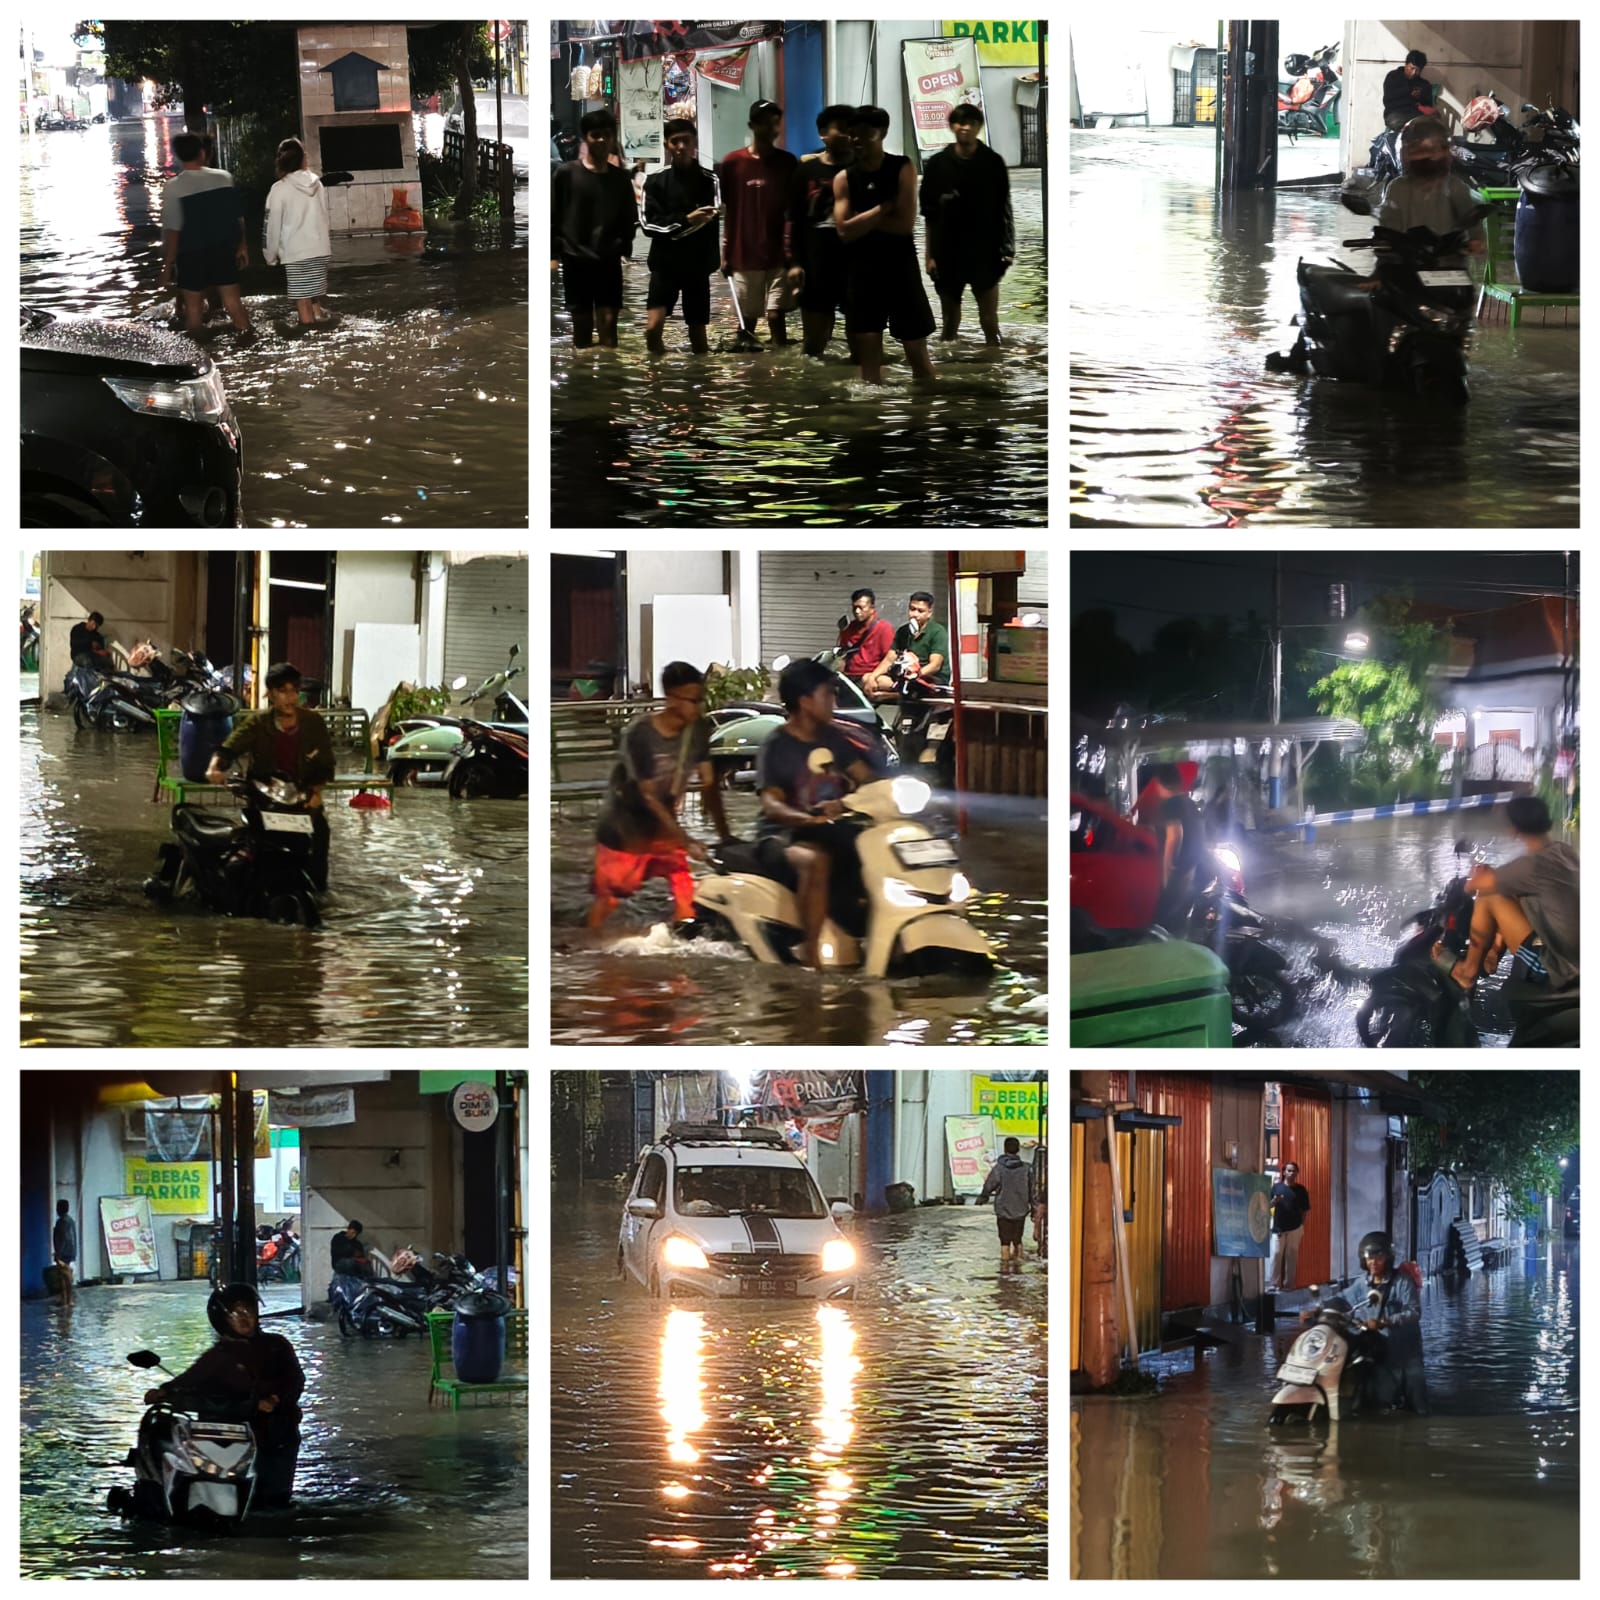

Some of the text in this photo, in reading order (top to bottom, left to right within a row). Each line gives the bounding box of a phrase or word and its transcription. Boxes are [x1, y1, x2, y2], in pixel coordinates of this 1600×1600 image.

[954, 21, 1048, 43] PARKI
[922, 72, 959, 90] OPEN
[793, 1076, 858, 1101] PRIMA
[464, 1109, 490, 1117] SUM
[151, 1169, 200, 1183] BEBAS
[133, 1184, 200, 1199] PARKIR
[112, 1217, 138, 1230] OPEN
